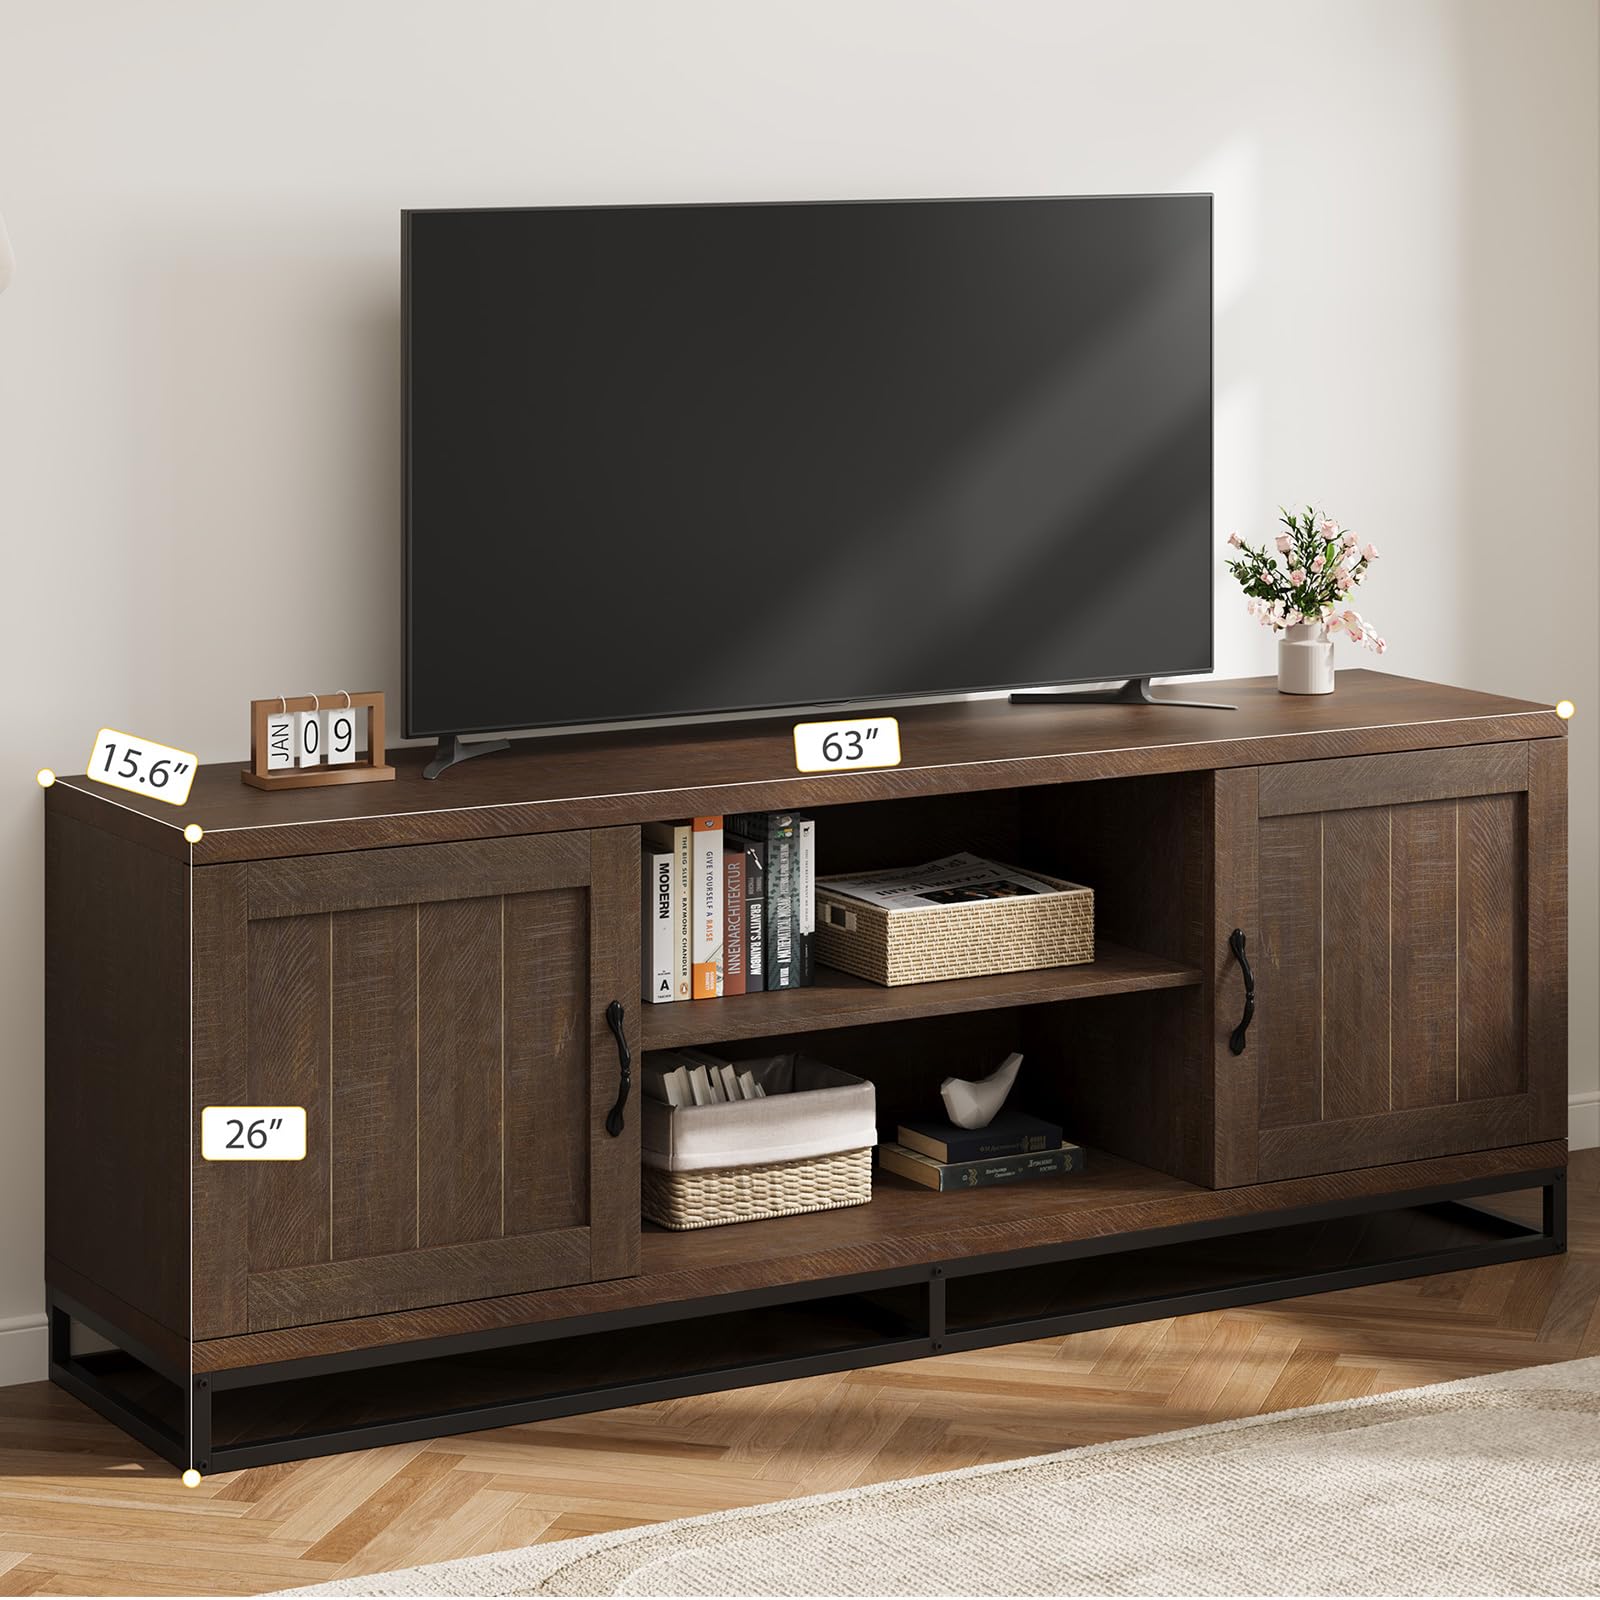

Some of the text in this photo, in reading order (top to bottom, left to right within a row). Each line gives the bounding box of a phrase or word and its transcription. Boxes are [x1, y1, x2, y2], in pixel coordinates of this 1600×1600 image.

[271, 723, 289, 762] JAN
[705, 850, 714, 869] GIVE
[659, 862, 670, 919] MODERN
[705, 870, 714, 909] YOURSELF
[705, 919, 714, 942] RAISE
[727, 862, 741, 975] INNENARCHITEKTUR
[749, 903, 762, 941] GRAVITY'S
[749, 941, 762, 975] RAINBOW
[660, 979, 670, 991] A
